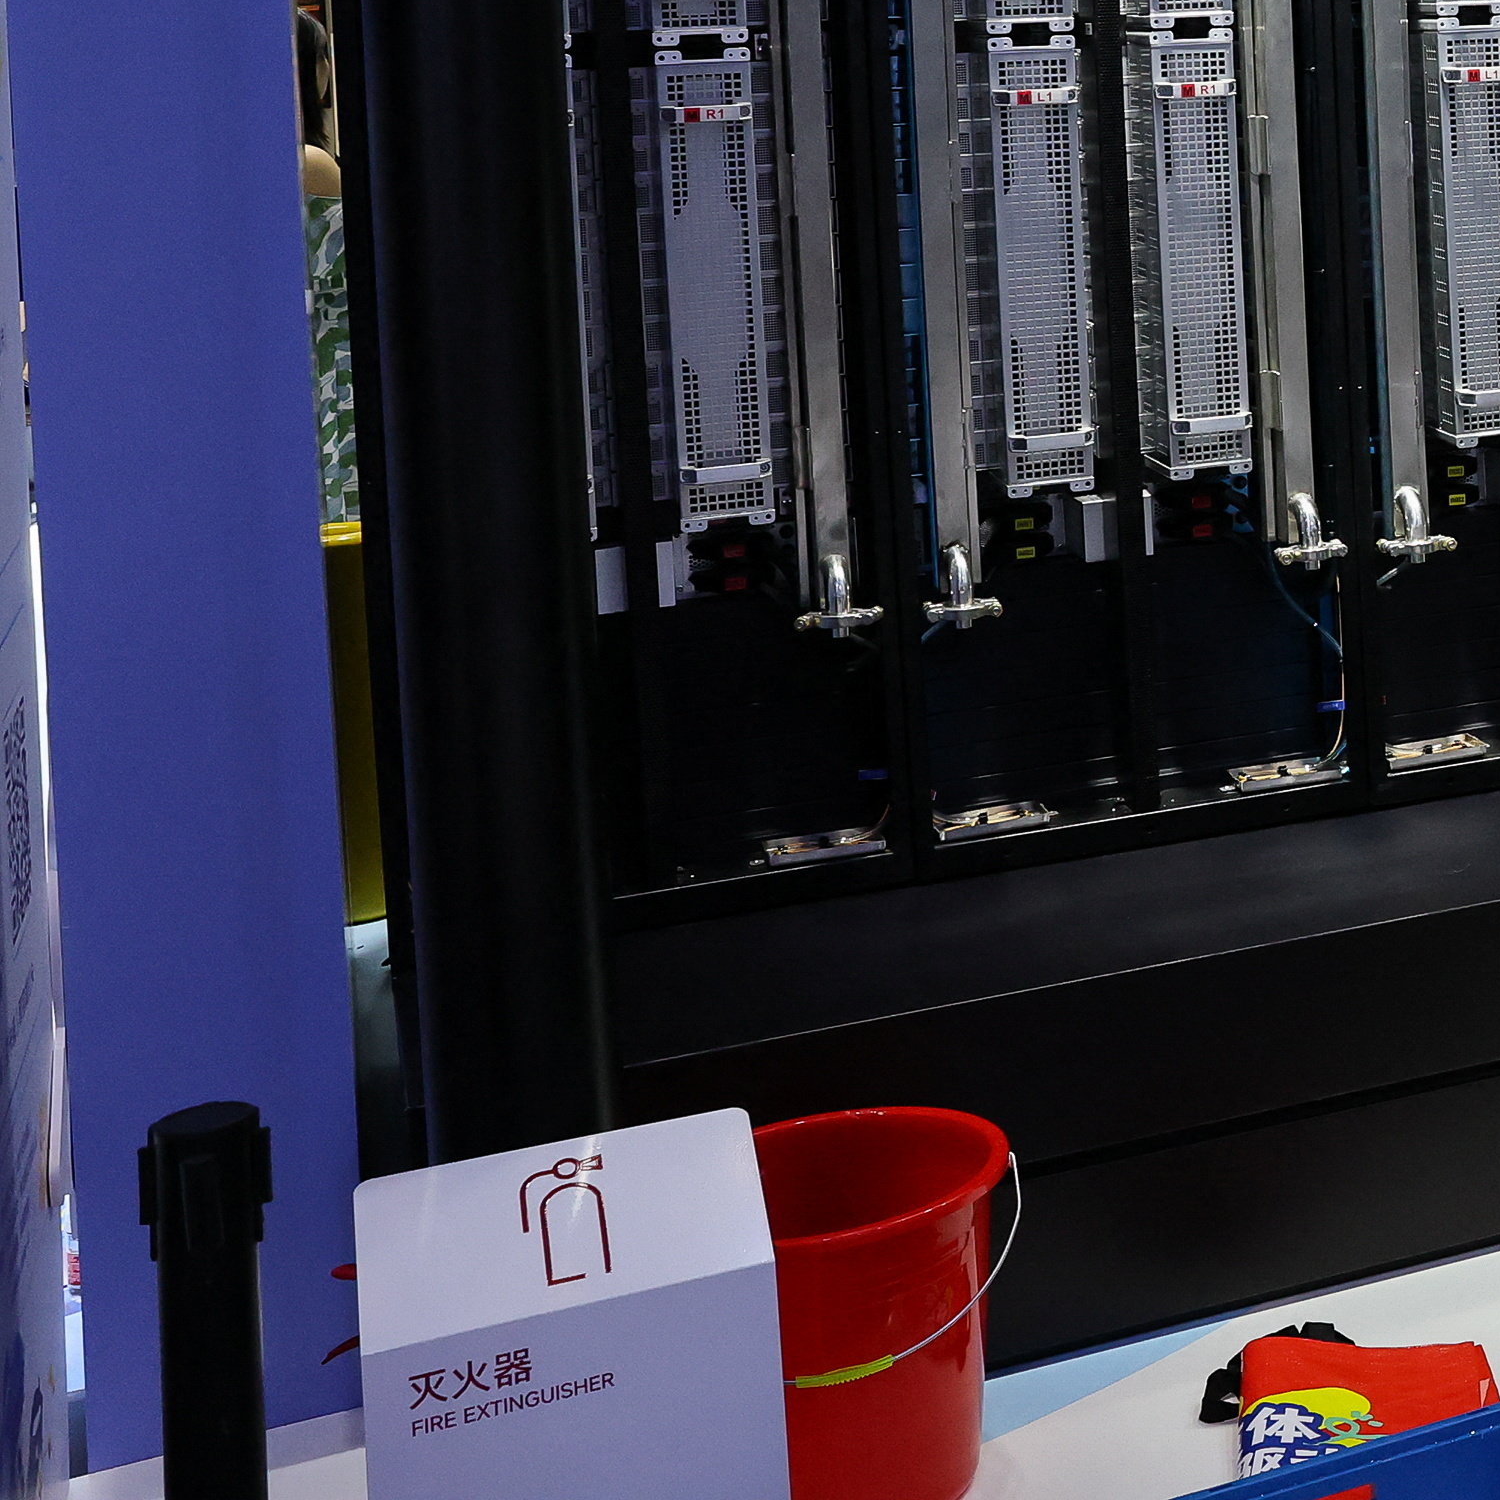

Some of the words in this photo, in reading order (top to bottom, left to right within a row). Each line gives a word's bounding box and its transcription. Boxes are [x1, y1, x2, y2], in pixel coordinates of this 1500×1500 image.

[1485, 70, 1498, 79] L1
[1200, 84, 1215, 94] R1
[1037, 92, 1052, 101] L1
[706, 109, 724, 119] R1
[408, 1347, 533, 1411] 灭火器
[411, 1411, 458, 1438] FIRE
[463, 1372, 616, 1424] EXTINGUISHER
